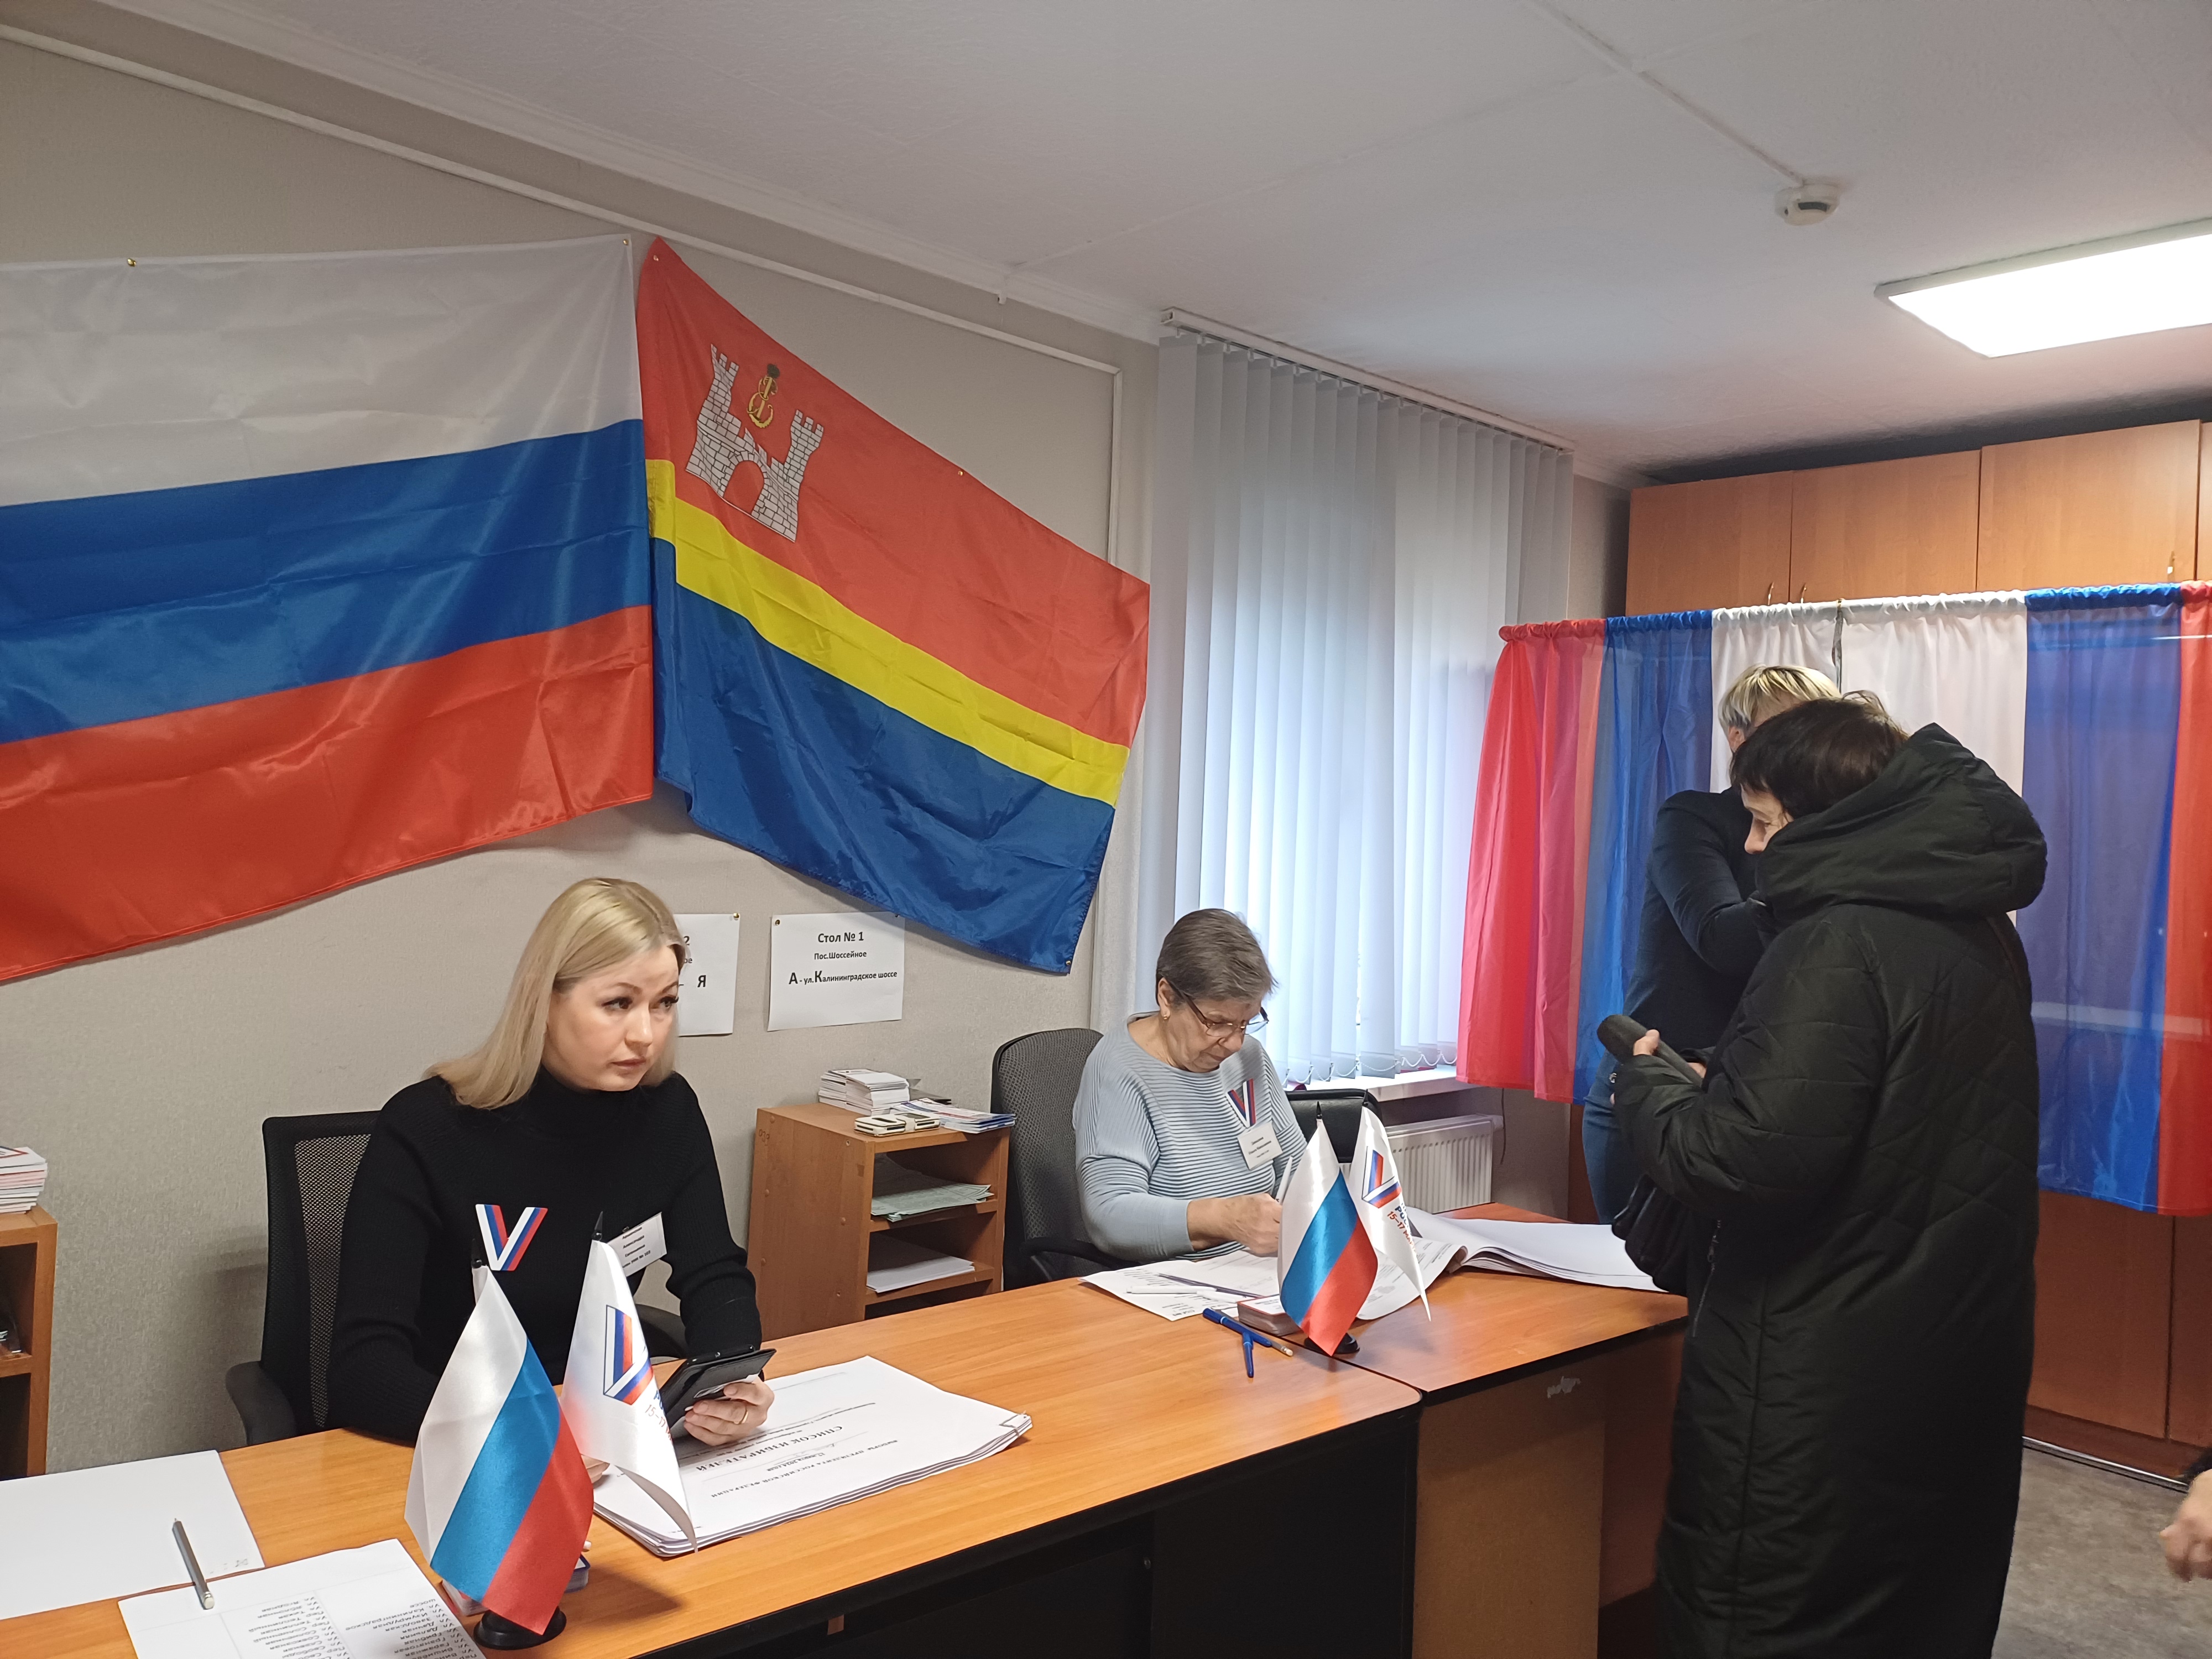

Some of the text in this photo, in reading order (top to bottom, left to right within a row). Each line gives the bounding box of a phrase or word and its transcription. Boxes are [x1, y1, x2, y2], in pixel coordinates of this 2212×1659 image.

[684, 936, 690, 946] 2
[818, 932, 864, 943] Стол № 1
[814, 951, 867, 960] Пос.Шоссейное
[697, 975, 706, 988] Я
[789, 972, 798, 984] А
[804, 971, 877, 985] ул.Калининградское
[790, 1426, 843, 1444] СПИСОК
[696, 1441, 789, 1472] ИЗБИРАТЕЛЕЙ
[762, 1464, 815, 1483] РОССИЙСКОЙ
[711, 1481, 760, 1498] ФЕДЕРАЦИИ
[410, 1598, 436, 1608] шоссе
[345, 1608, 424, 1631] Калининградское
[373, 1612, 427, 1630] Изумрудная
[385, 1617, 431, 1632] Заводская
[400, 1626, 438, 1640] Дальняя
[402, 1621, 435, 1634] Дачная
[394, 1637, 446, 1653] Гранатовая
[404, 1632, 442, 1645] Грибная
[282, 1646, 326, 1658] Свободы
[405, 1642, 450, 1657] Гаражная
